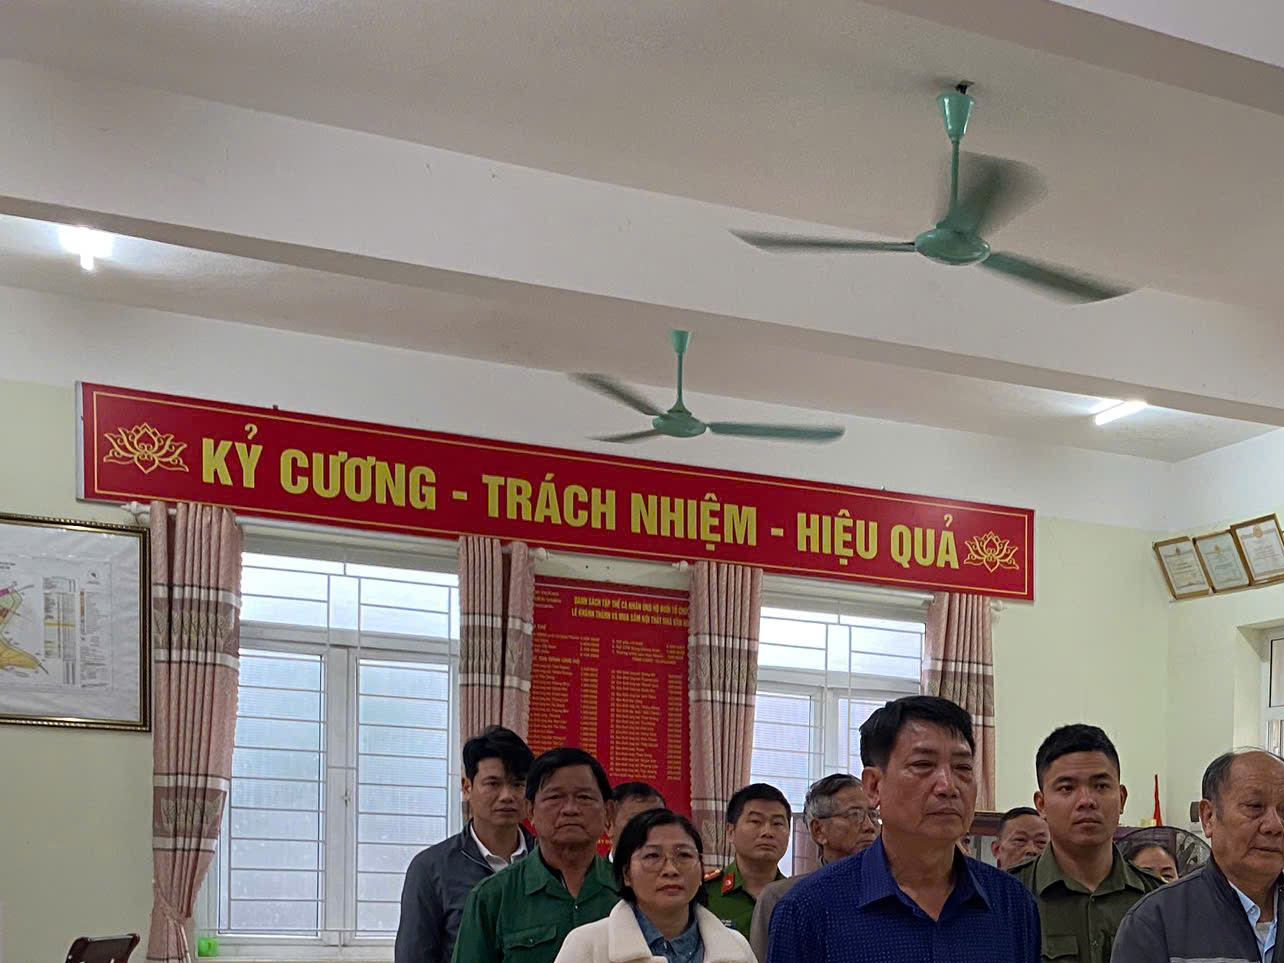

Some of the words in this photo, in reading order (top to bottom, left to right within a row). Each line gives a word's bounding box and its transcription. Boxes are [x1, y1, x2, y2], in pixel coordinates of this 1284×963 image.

[203, 423, 263, 489] KỶ
[280, 449, 436, 510] CƯƠNG
[482, 473, 616, 531] TRÁCH
[631, 493, 757, 551] NHIỆM
[797, 510, 878, 565] HIỆU
[890, 515, 959, 569] QUẢ
